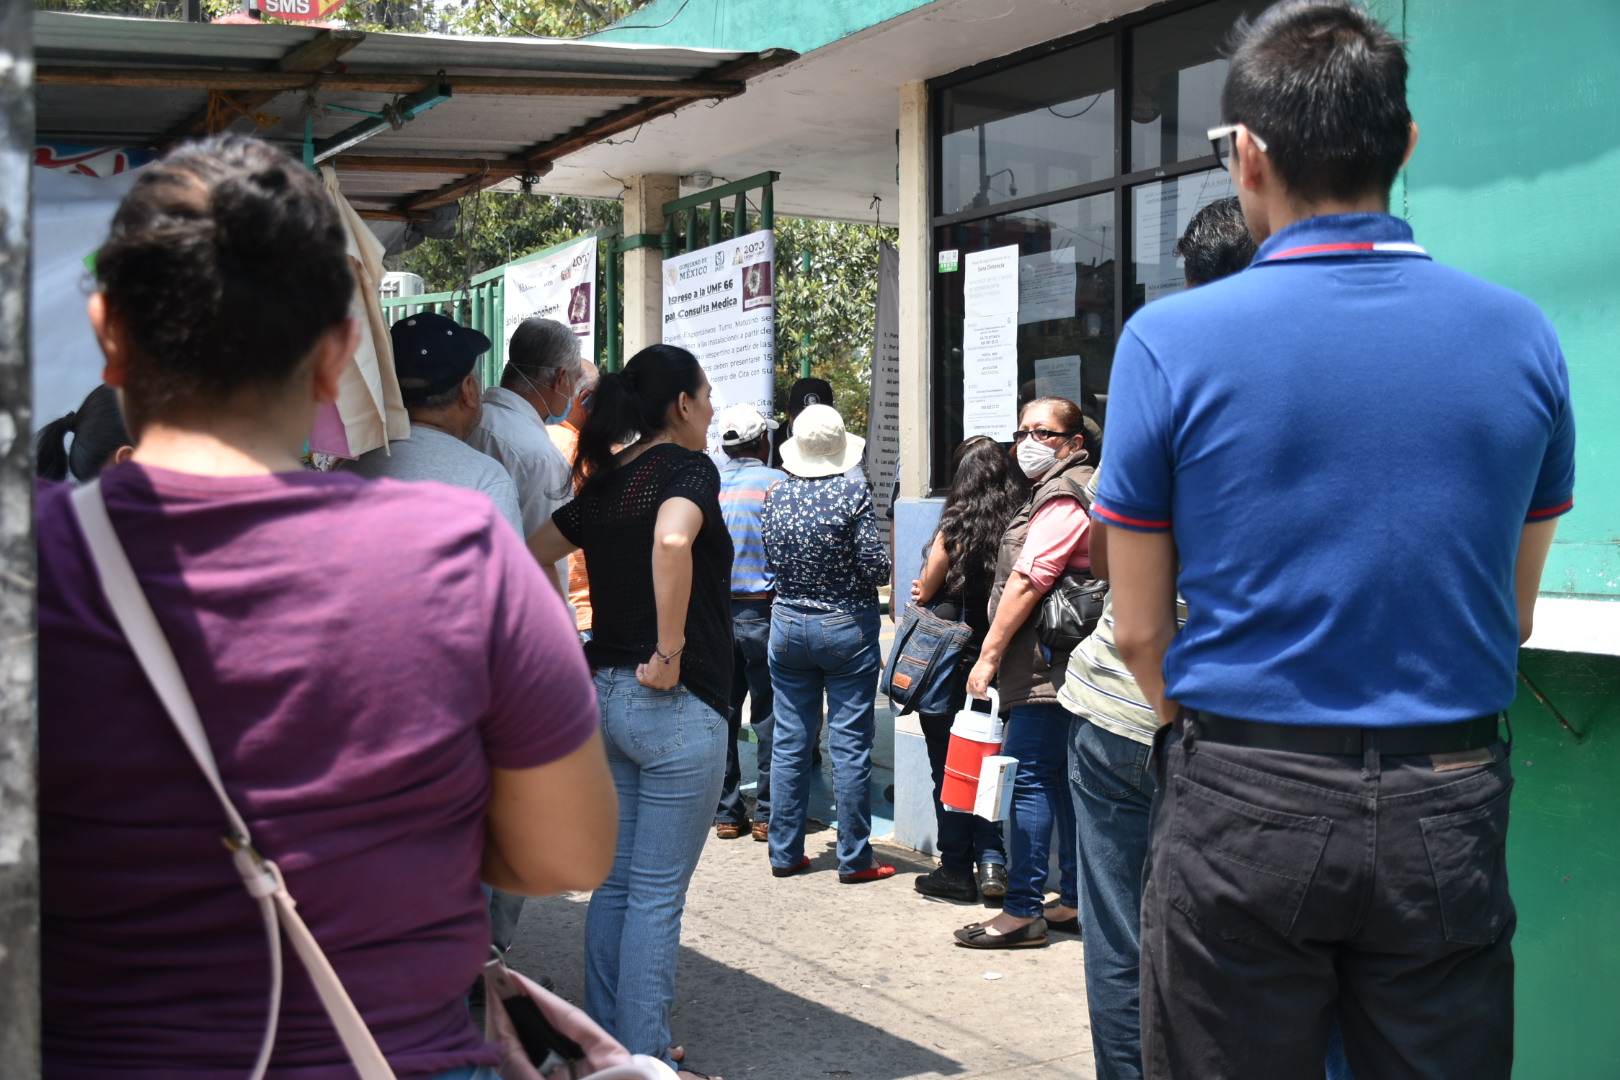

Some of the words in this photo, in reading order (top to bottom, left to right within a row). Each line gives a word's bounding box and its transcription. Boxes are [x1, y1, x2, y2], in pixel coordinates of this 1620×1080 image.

[265, 0, 310, 14] SMS
[679, 265, 708, 280] MÉXICO
[700, 288, 706, 296] la
[706, 282, 722, 295] UMF
[724, 278, 734, 290] 66
[678, 304, 710, 318] Consulta
[712, 296, 738, 310] Medica
[708, 334, 740, 346] instalaciones
[744, 329, 760, 340] partir
[760, 326, 772, 334] de
[736, 343, 751, 353] partir
[714, 361, 728, 370] deben
[730, 356, 760, 368] presentarse
[738, 370, 750, 378] Cita
[757, 398, 772, 407] Cita
